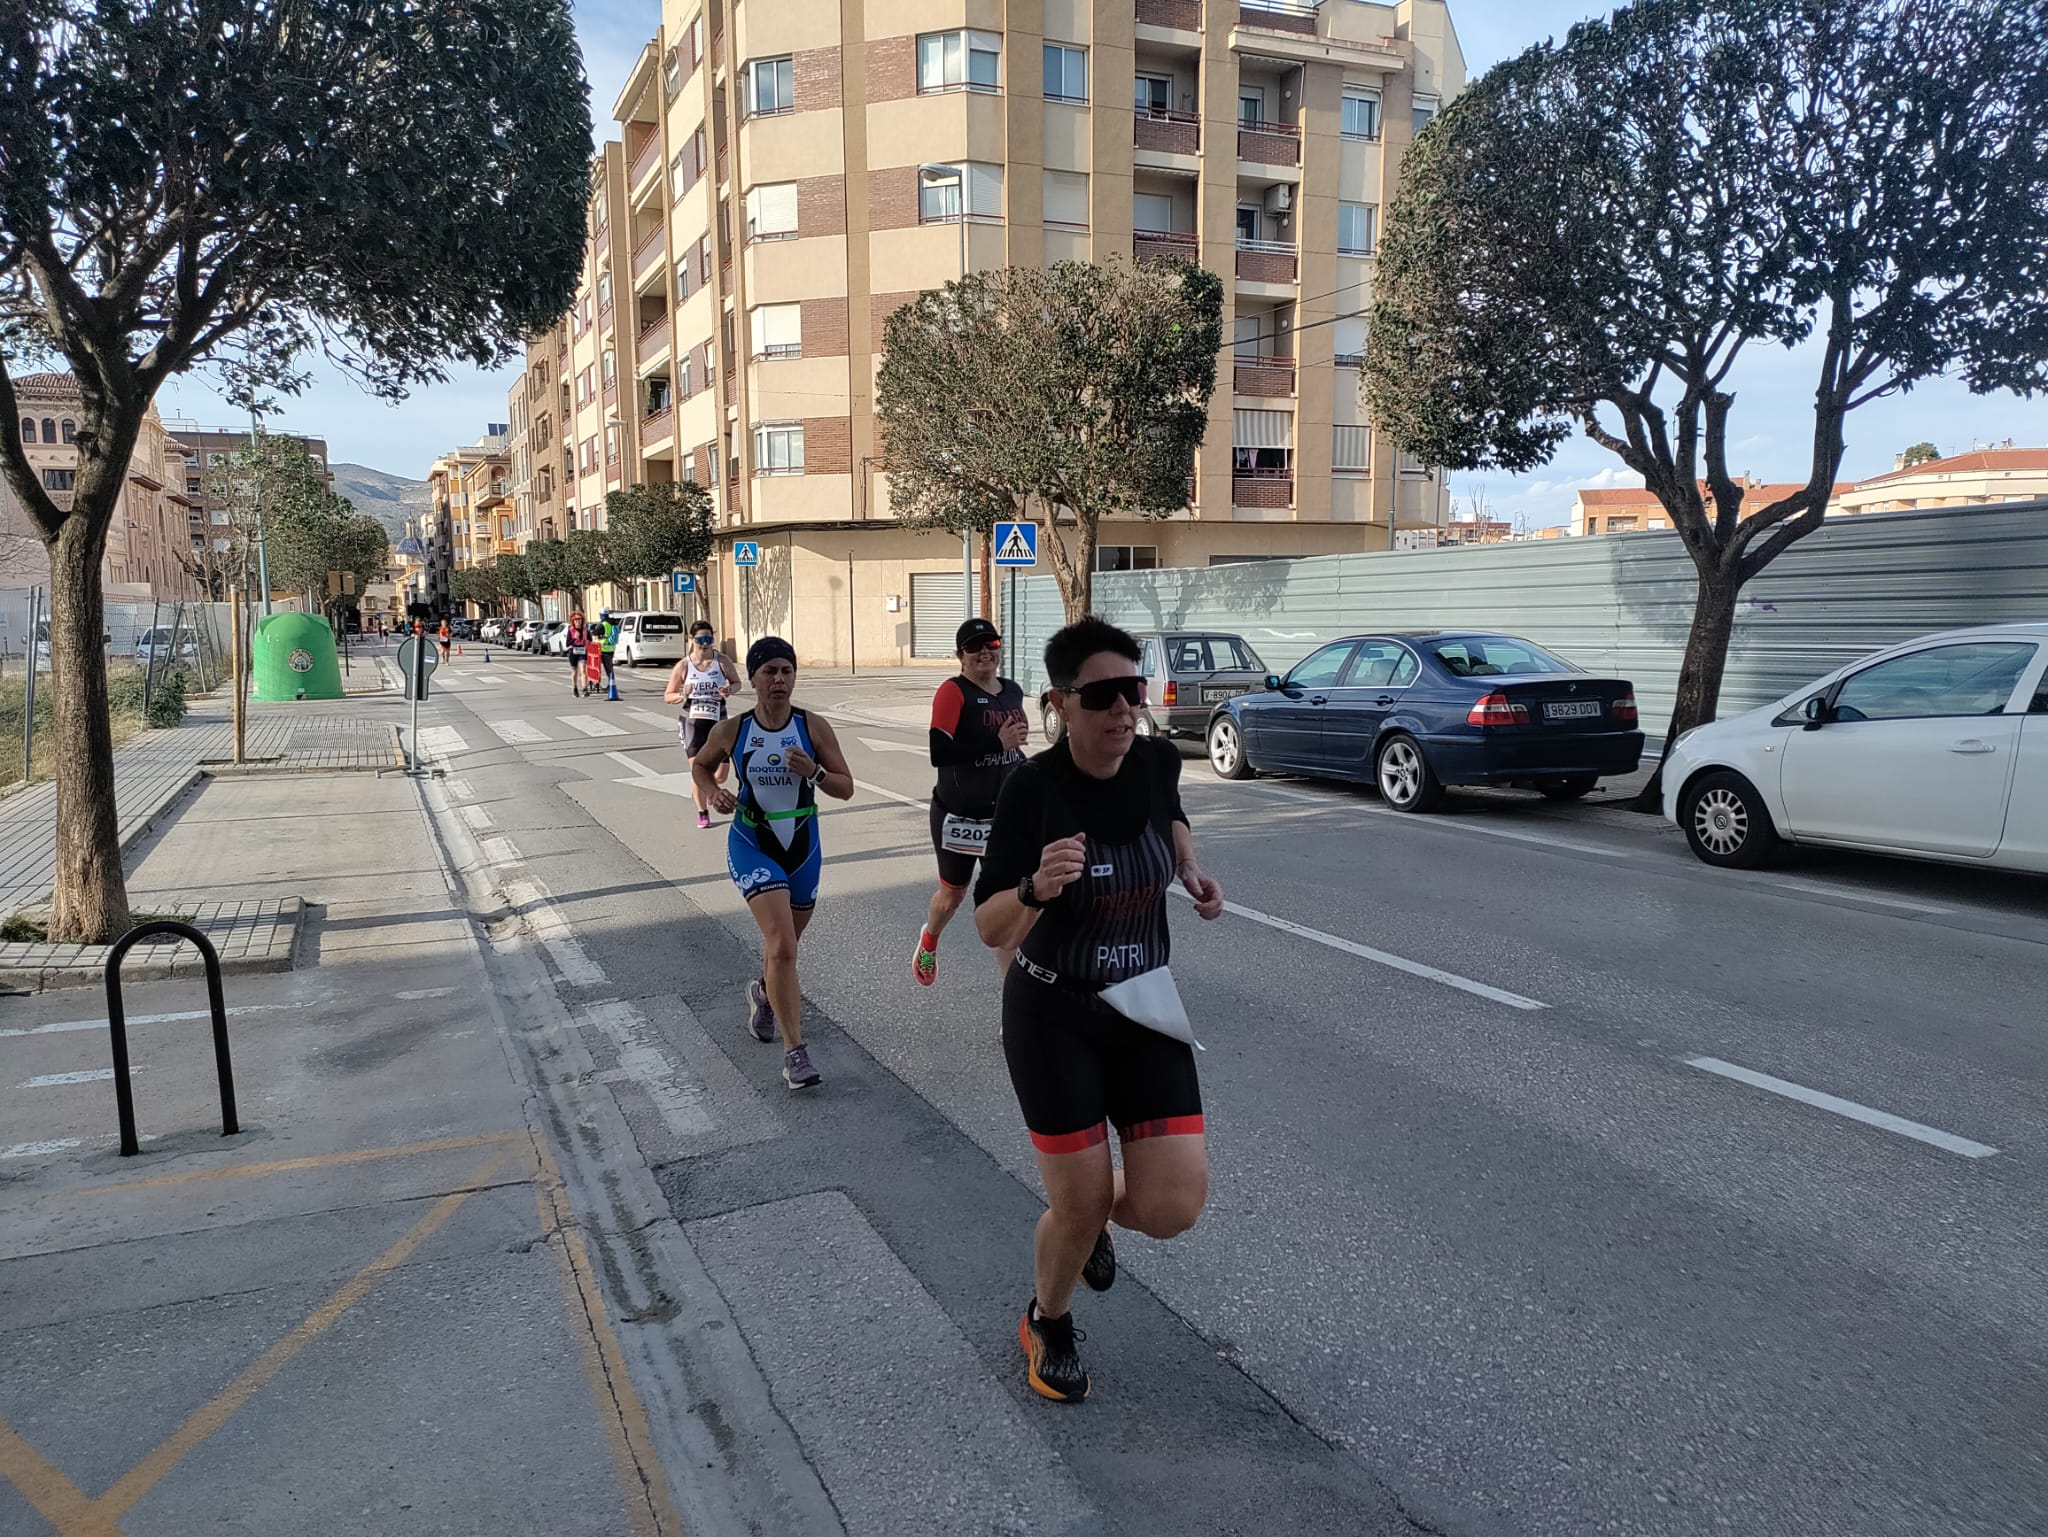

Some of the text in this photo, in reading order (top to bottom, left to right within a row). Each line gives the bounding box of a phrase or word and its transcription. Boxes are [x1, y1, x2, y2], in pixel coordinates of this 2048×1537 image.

[694, 704, 718, 714] 4122
[1551, 702, 1598, 716] 9829 DDV
[758, 775, 793, 786] SILVIA
[950, 827, 992, 841] 5202
[1097, 942, 1144, 969] PATRI
